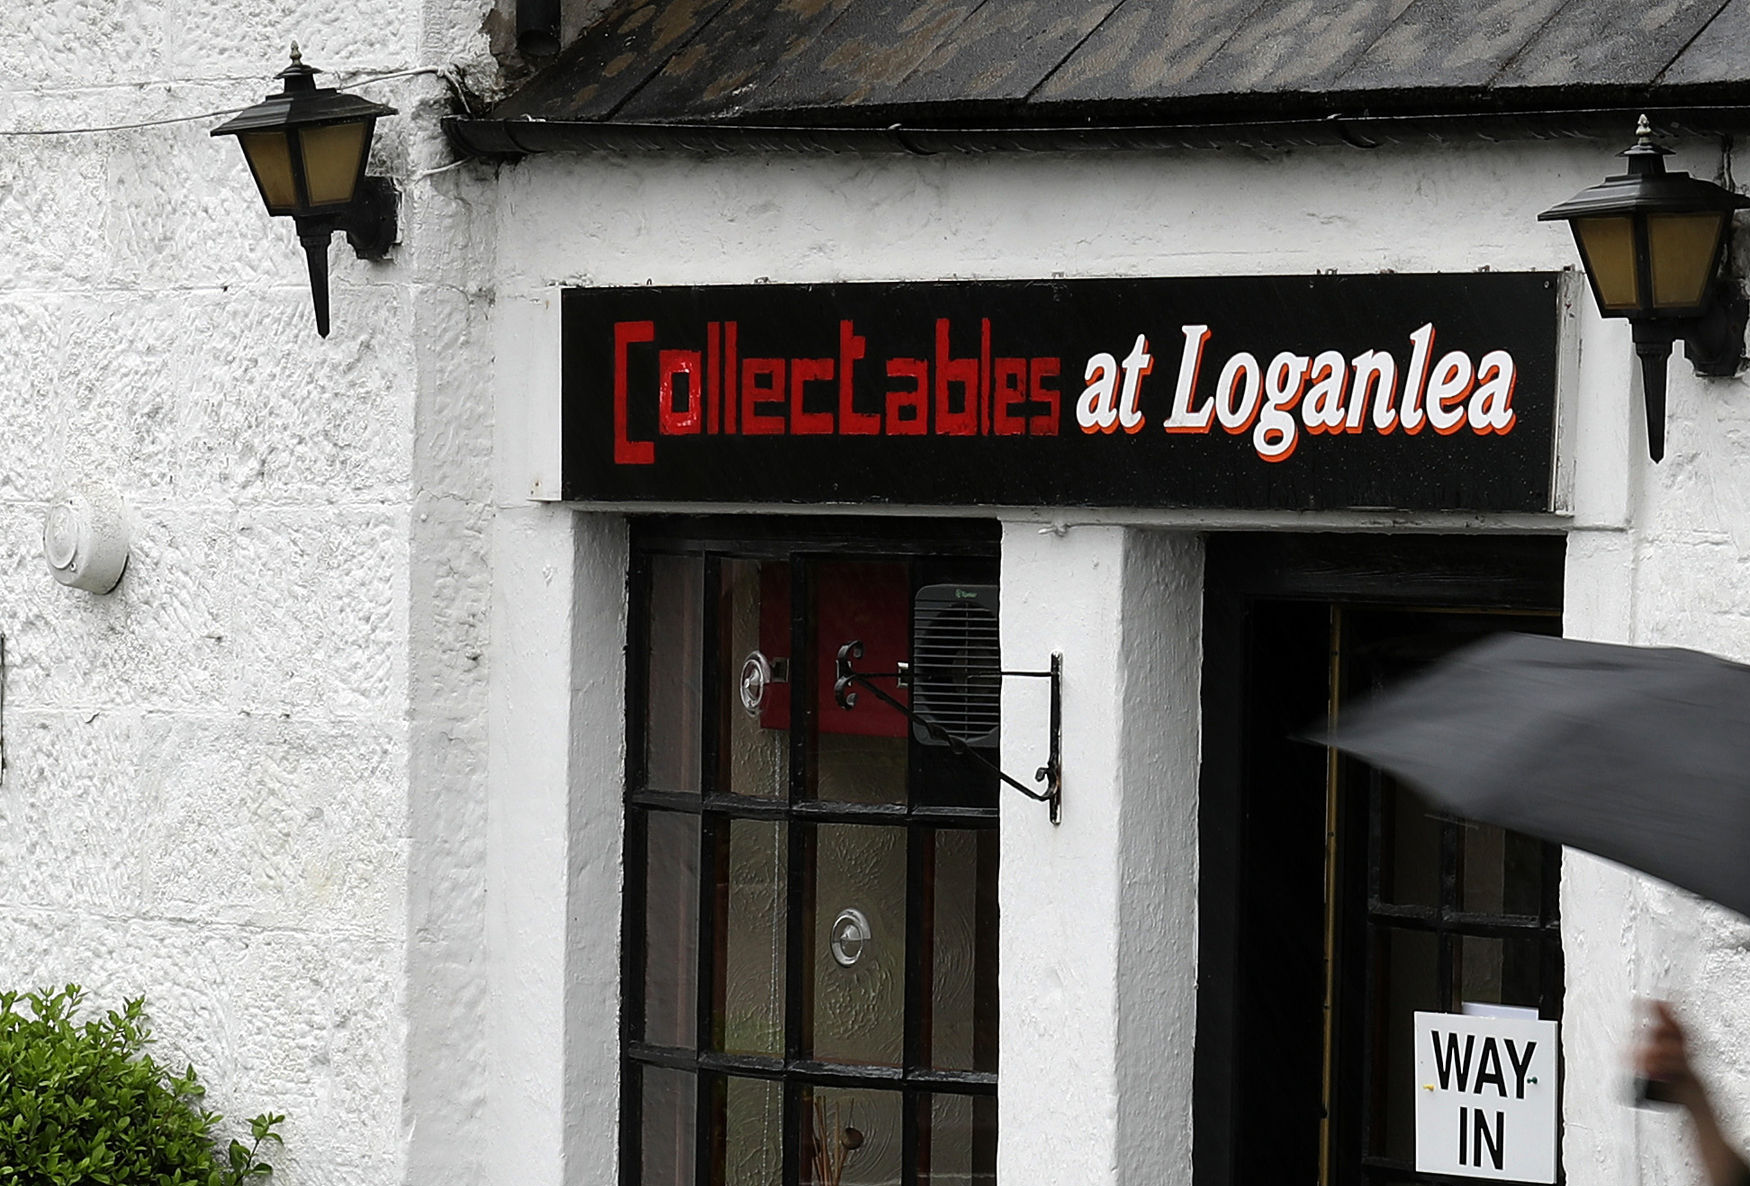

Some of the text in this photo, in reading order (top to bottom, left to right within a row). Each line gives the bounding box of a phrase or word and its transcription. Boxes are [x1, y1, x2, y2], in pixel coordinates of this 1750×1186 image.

[614, 317, 1517, 465] Collectables at Loganlea
[1431, 1030, 1537, 1100] WAY
[1459, 1106, 1505, 1171] IN
